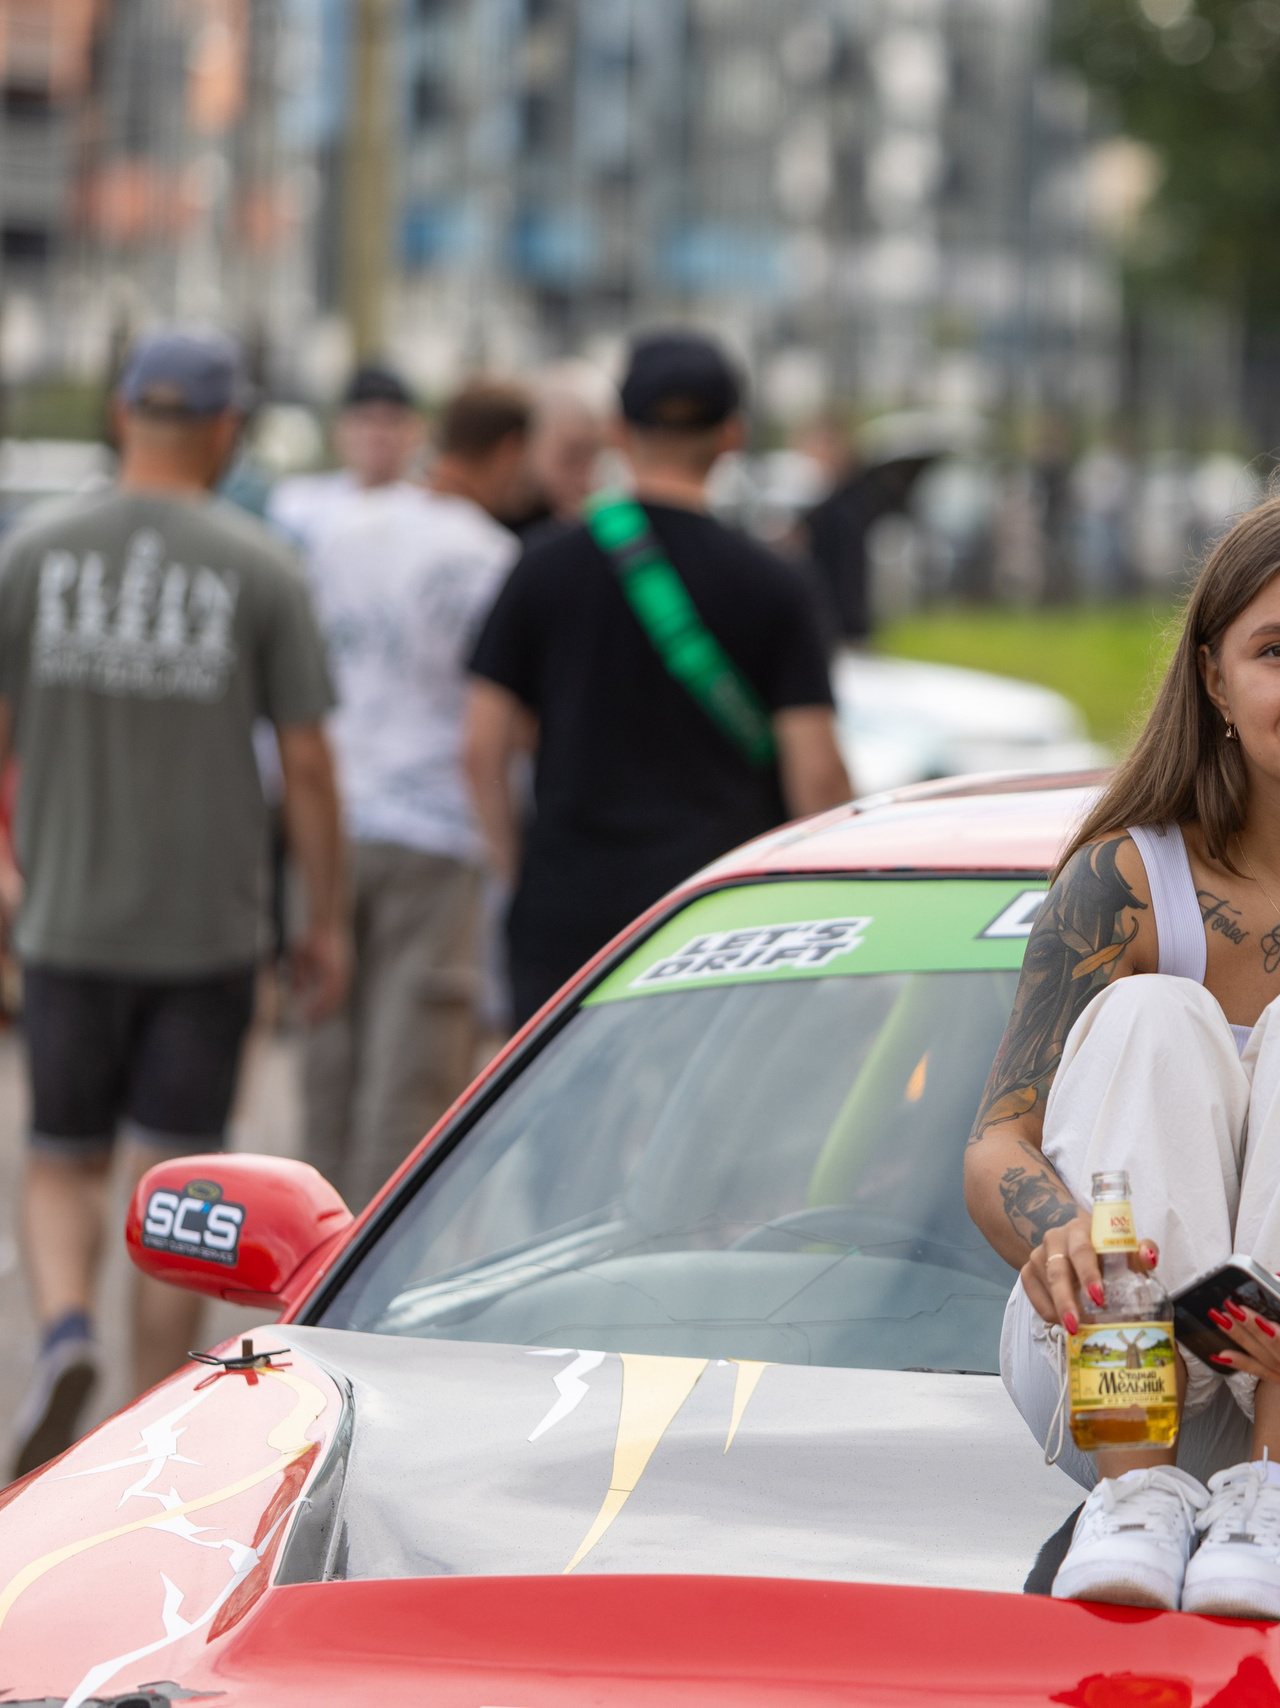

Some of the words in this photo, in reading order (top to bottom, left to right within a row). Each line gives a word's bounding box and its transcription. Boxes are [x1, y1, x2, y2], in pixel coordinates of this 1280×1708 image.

[680, 919, 859, 956] LET'S
[645, 938, 852, 980] DRIFT
[1098, 1370, 1165, 1394] Мельник
[1118, 1368, 1156, 1380] Старый
